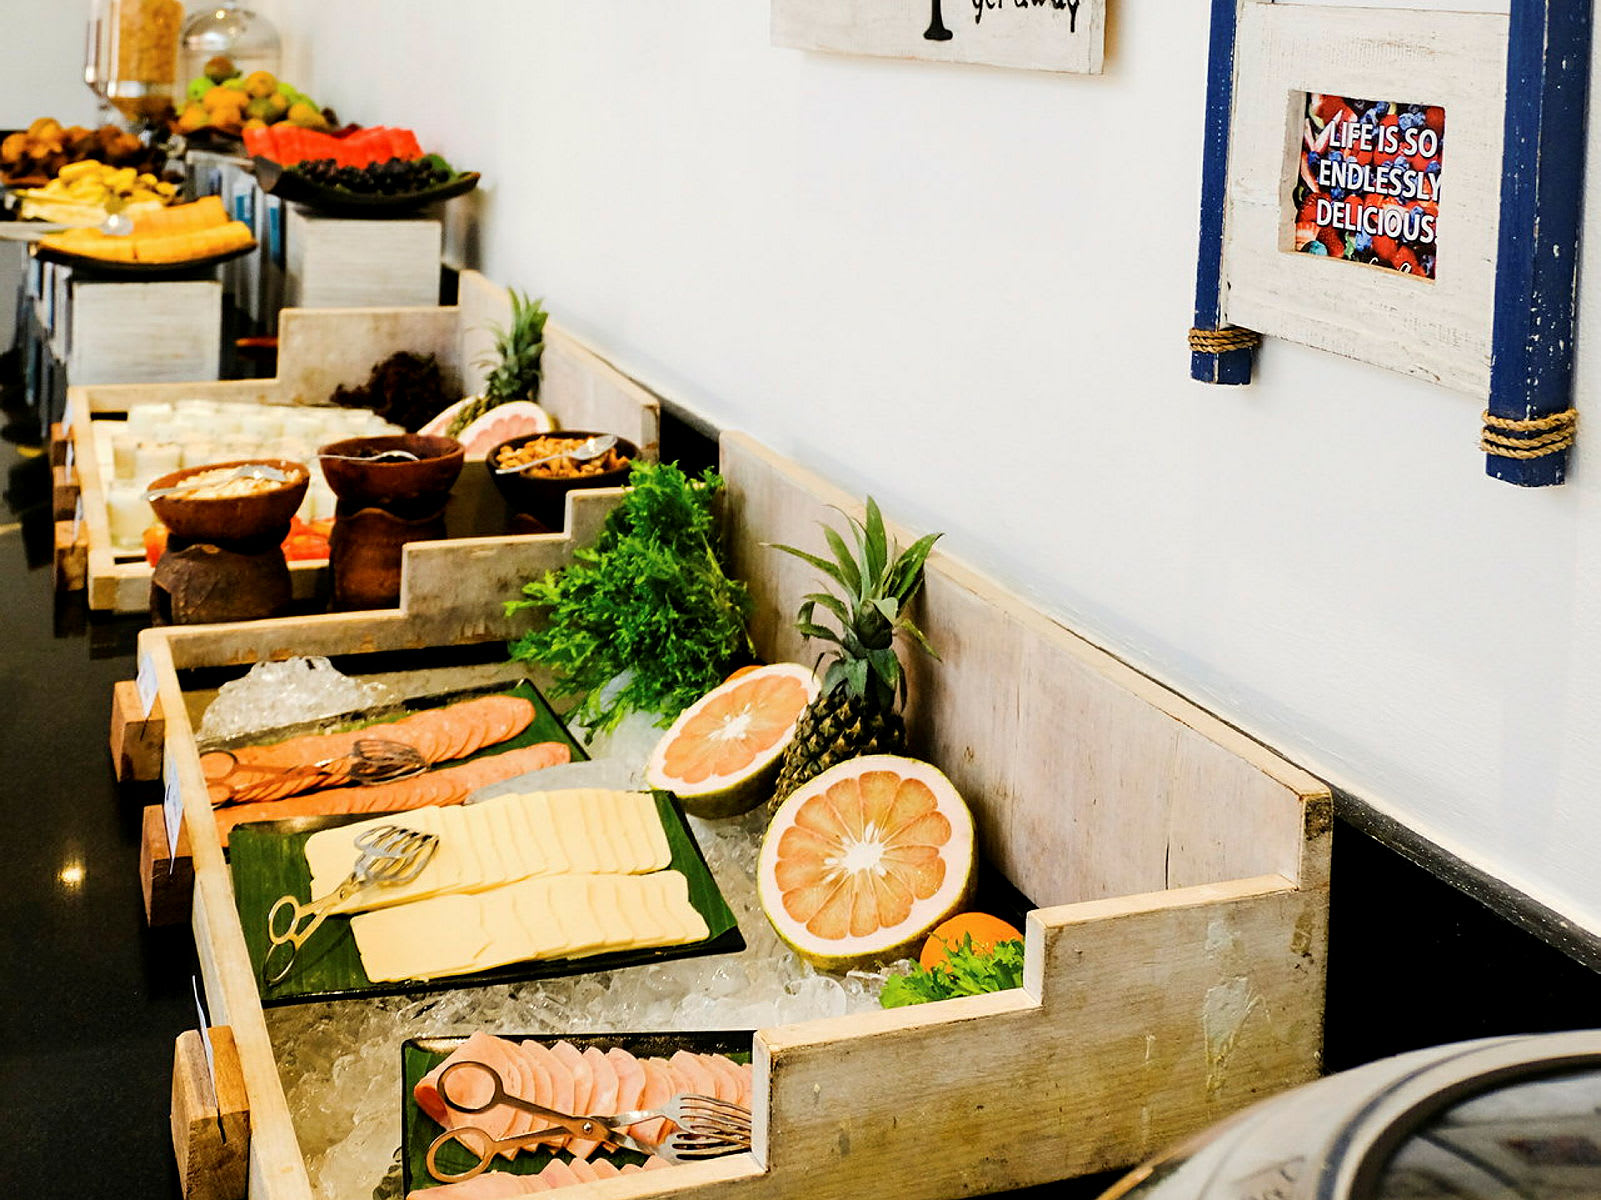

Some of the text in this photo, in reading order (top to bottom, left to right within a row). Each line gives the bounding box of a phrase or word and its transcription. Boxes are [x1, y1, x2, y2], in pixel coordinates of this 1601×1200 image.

[1329, 119, 1437, 158] LIFE IS SO
[1319, 159, 1442, 202] ENDLESSLY
